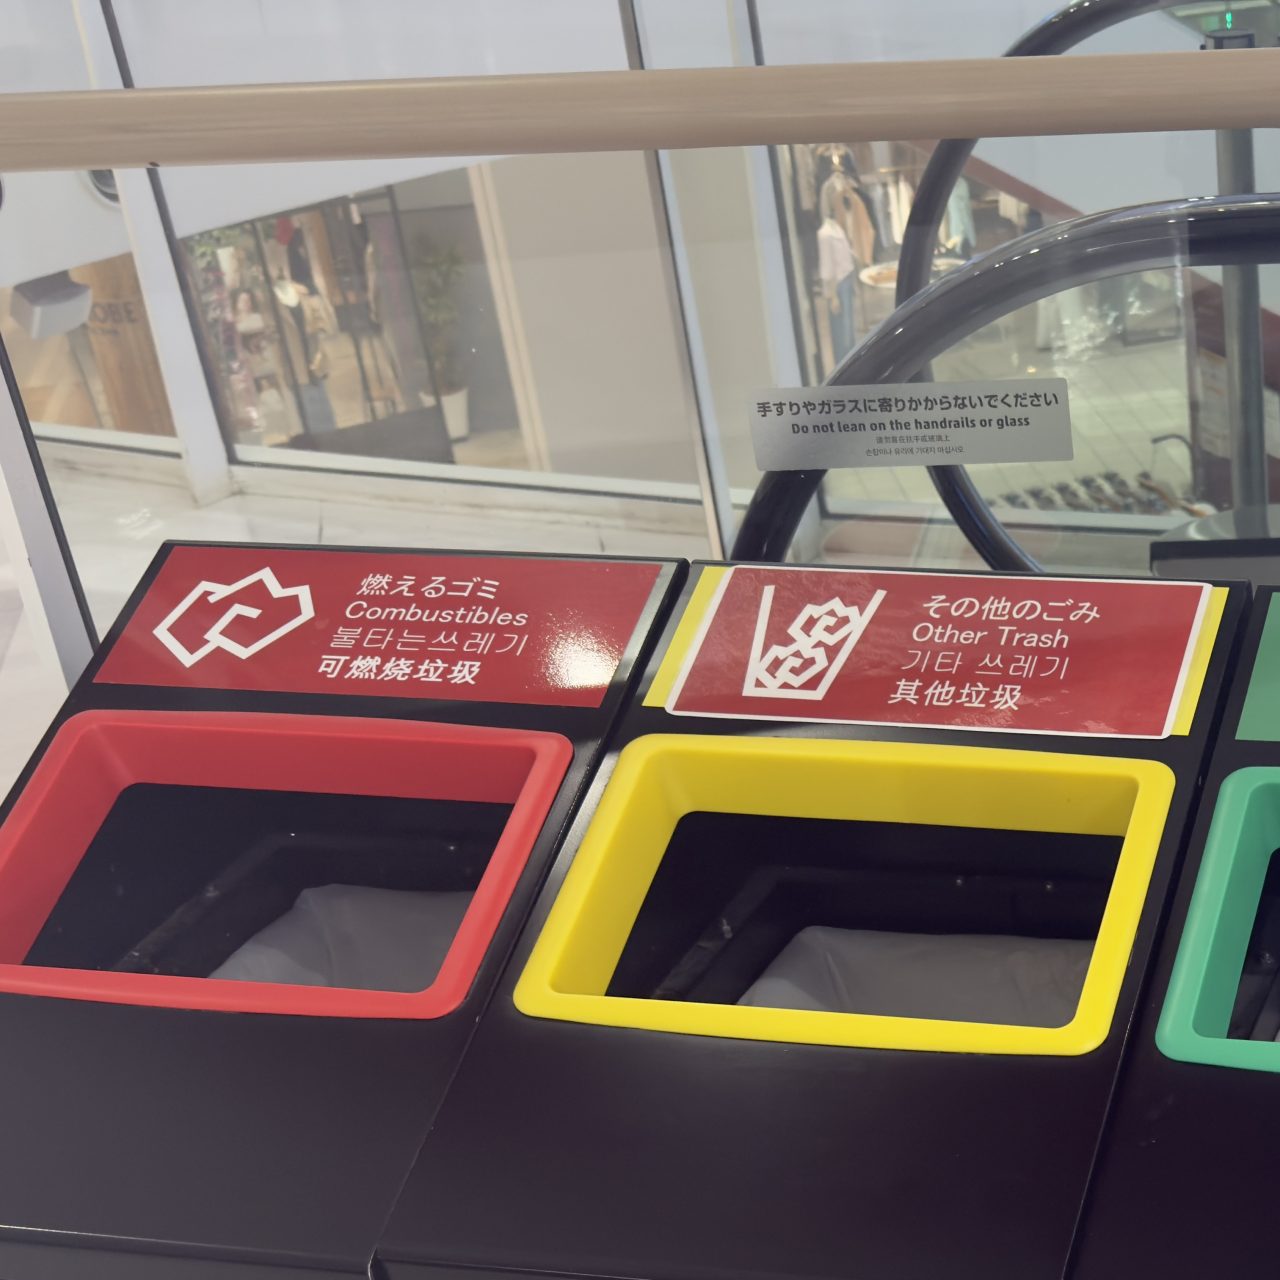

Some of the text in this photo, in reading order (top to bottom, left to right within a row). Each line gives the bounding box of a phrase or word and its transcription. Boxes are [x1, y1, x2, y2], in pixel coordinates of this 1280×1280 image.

[756, 392, 1059, 418] 手すりやガラスに寄りかからないでください
[791, 415, 1030, 434] Do not lean on the handrails or glass
[356, 573, 500, 600] 燃えるゴミ
[344, 600, 529, 626] Combustibles
[922, 594, 1101, 624] その他のごみ
[911, 622, 1069, 649] Other Trash
[317, 654, 482, 685] 可燃烧垃圾
[900, 649, 1070, 680] 기타 쓰레기
[887, 678, 1022, 711] 其他垃圾
